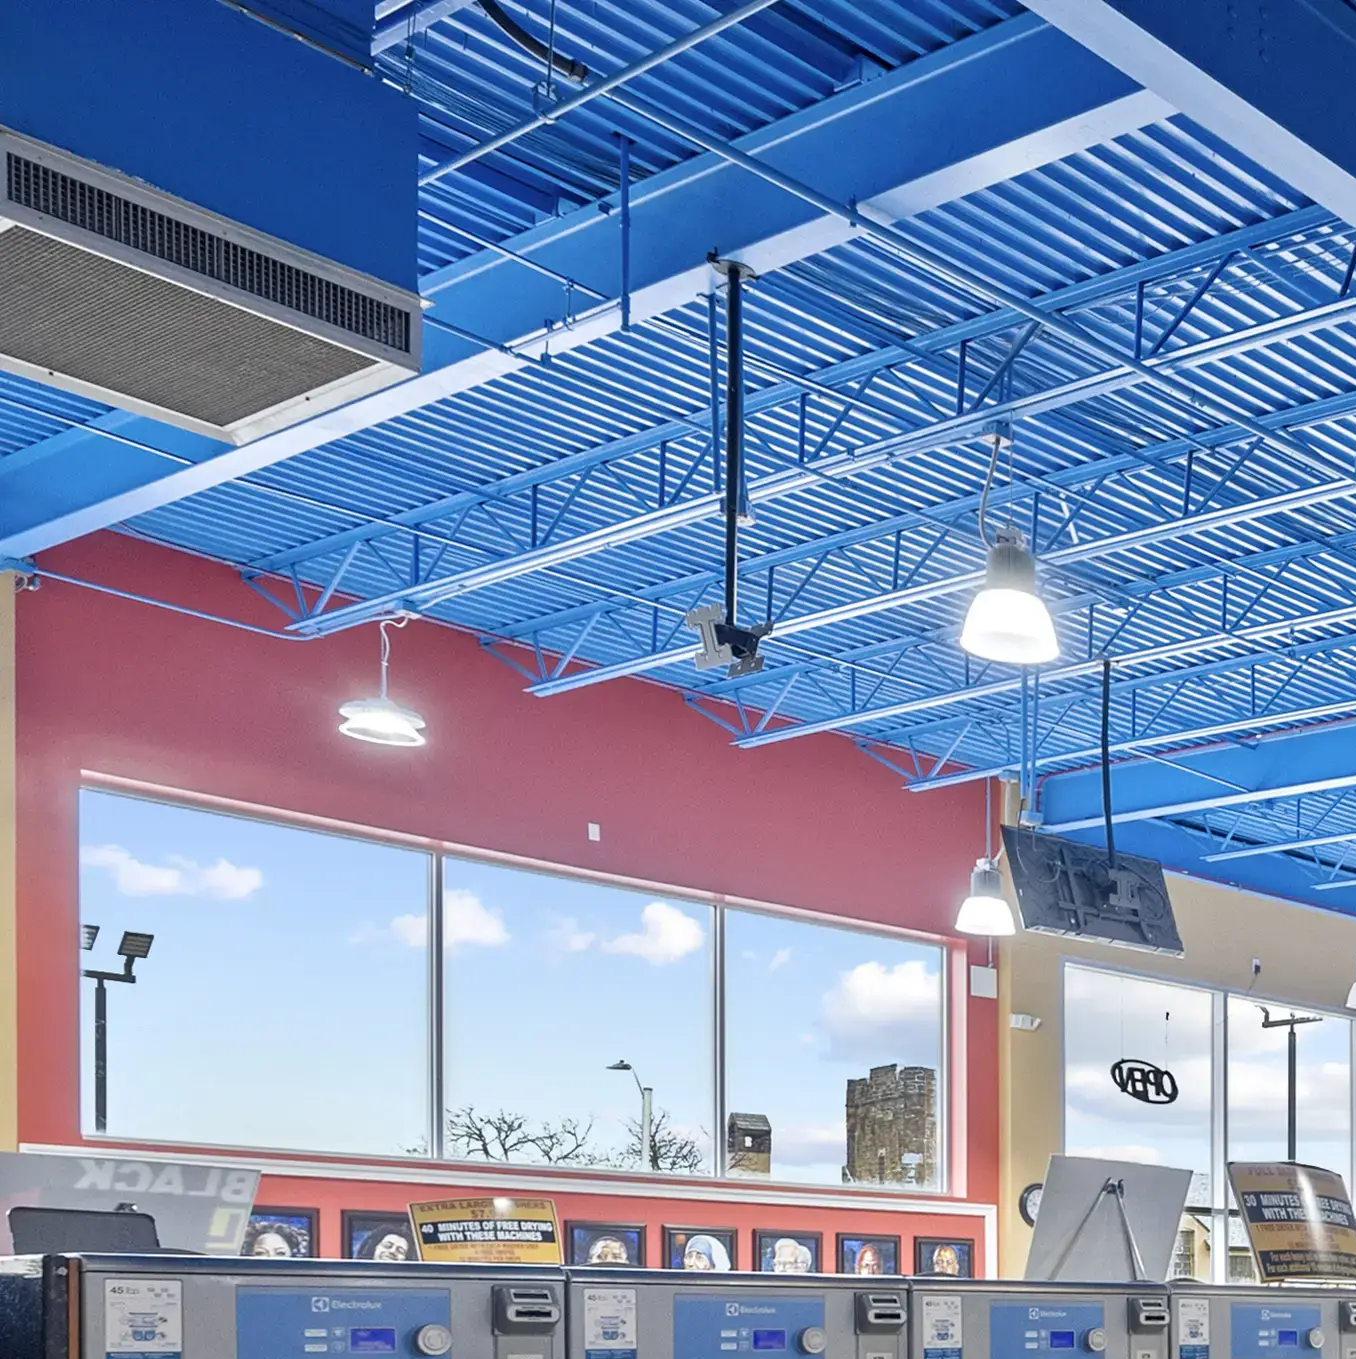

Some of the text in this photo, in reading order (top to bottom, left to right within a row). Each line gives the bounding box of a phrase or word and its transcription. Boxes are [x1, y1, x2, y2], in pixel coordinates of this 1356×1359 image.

[1243, 1194, 1257, 1207] 30
[1260, 1194, 1300, 1207] MINUTES
[419, 1201, 456, 1212] EXTRA
[1262, 1207, 1287, 1220] WITH
[437, 1222, 481, 1232] MINUTES
[482, 1221, 495, 1231] OF
[496, 1221, 520, 1231] FREE
[520, 1221, 553, 1232] DRYING
[437, 1231, 543, 1242] WITH THESE MACHINES
[109, 1286, 124, 1295] 45
[331, 1300, 382, 1310] Electrolux
